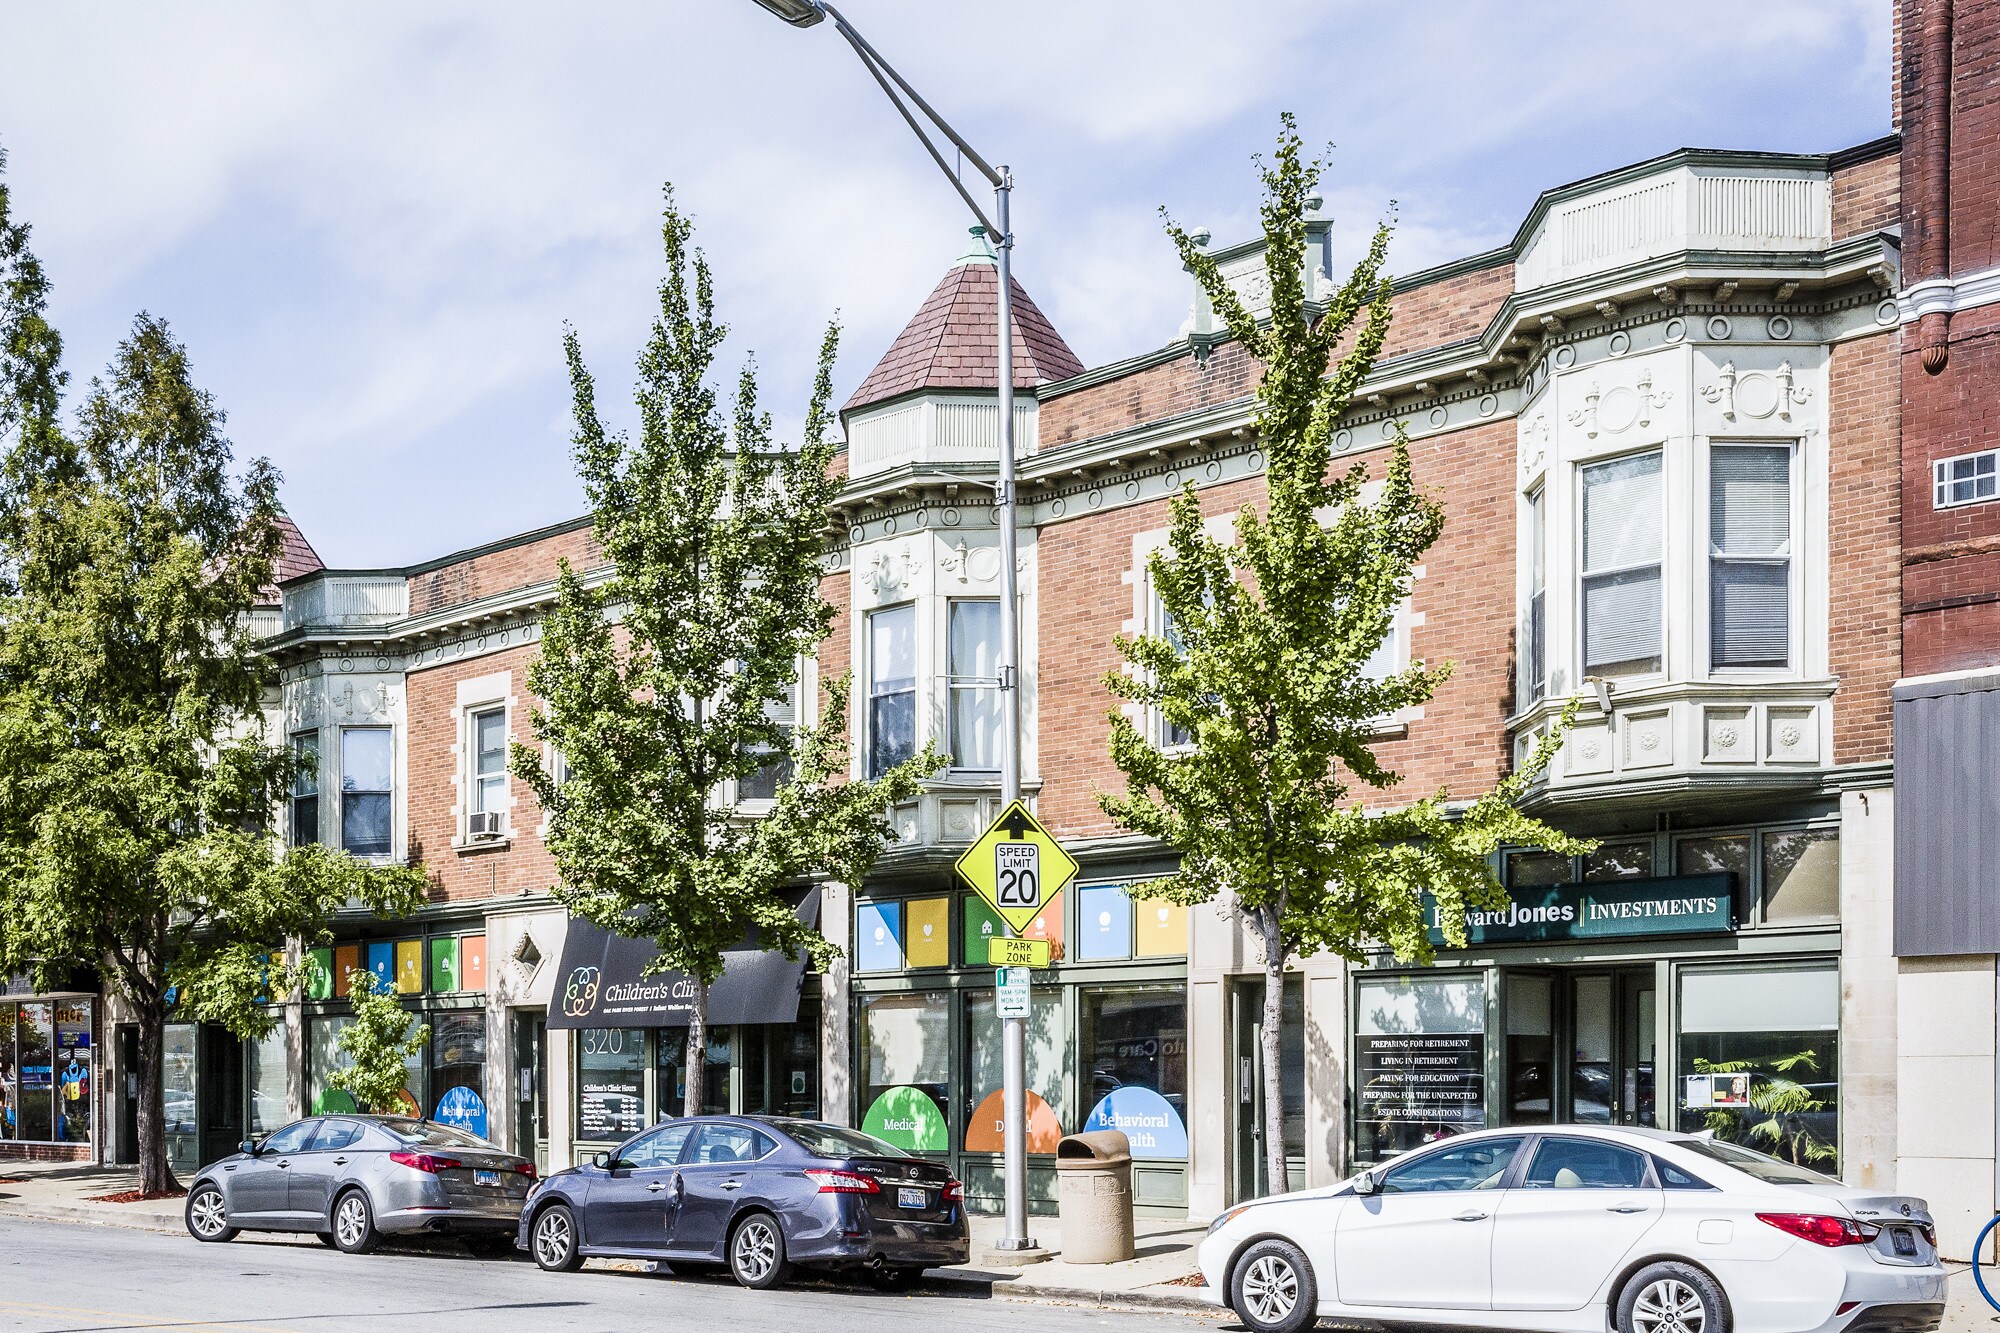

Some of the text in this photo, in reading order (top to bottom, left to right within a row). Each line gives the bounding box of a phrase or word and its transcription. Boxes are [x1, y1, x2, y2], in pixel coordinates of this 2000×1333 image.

[999, 847, 1035, 857] SPEED
[1003, 858, 1031, 868] LIMIT
[999, 869, 1036, 904] 20
[1508, 902, 1574, 928] Jones
[1589, 897, 1717, 920] INVESTMENTS
[1006, 941, 1032, 952] PARK
[1006, 953, 1032, 963] ZONE
[605, 983, 668, 1002] Children's
[584, 1028, 623, 1054] 320
[1371, 1040, 1469, 1048] PREPARING FOR RETIREMENT
[1381, 1057, 1459, 1065] LIVING IN RETIREMENT
[1379, 1074, 1460, 1082] PAYING FOR EDUCATION
[1363, 1091, 1477, 1100] PREPARING FOR THE UNEXPECTED
[442, 1105, 480, 1117] Behavioral
[1377, 1108, 1462, 1117] ESTATE CONSIDERATIONS
[884, 1118, 924, 1131] Medical
[1099, 1112, 1169, 1128] Behavioral
[1129, 1132, 1156, 1148] alth
[1256, 1245, 1294, 1259] COOPER
